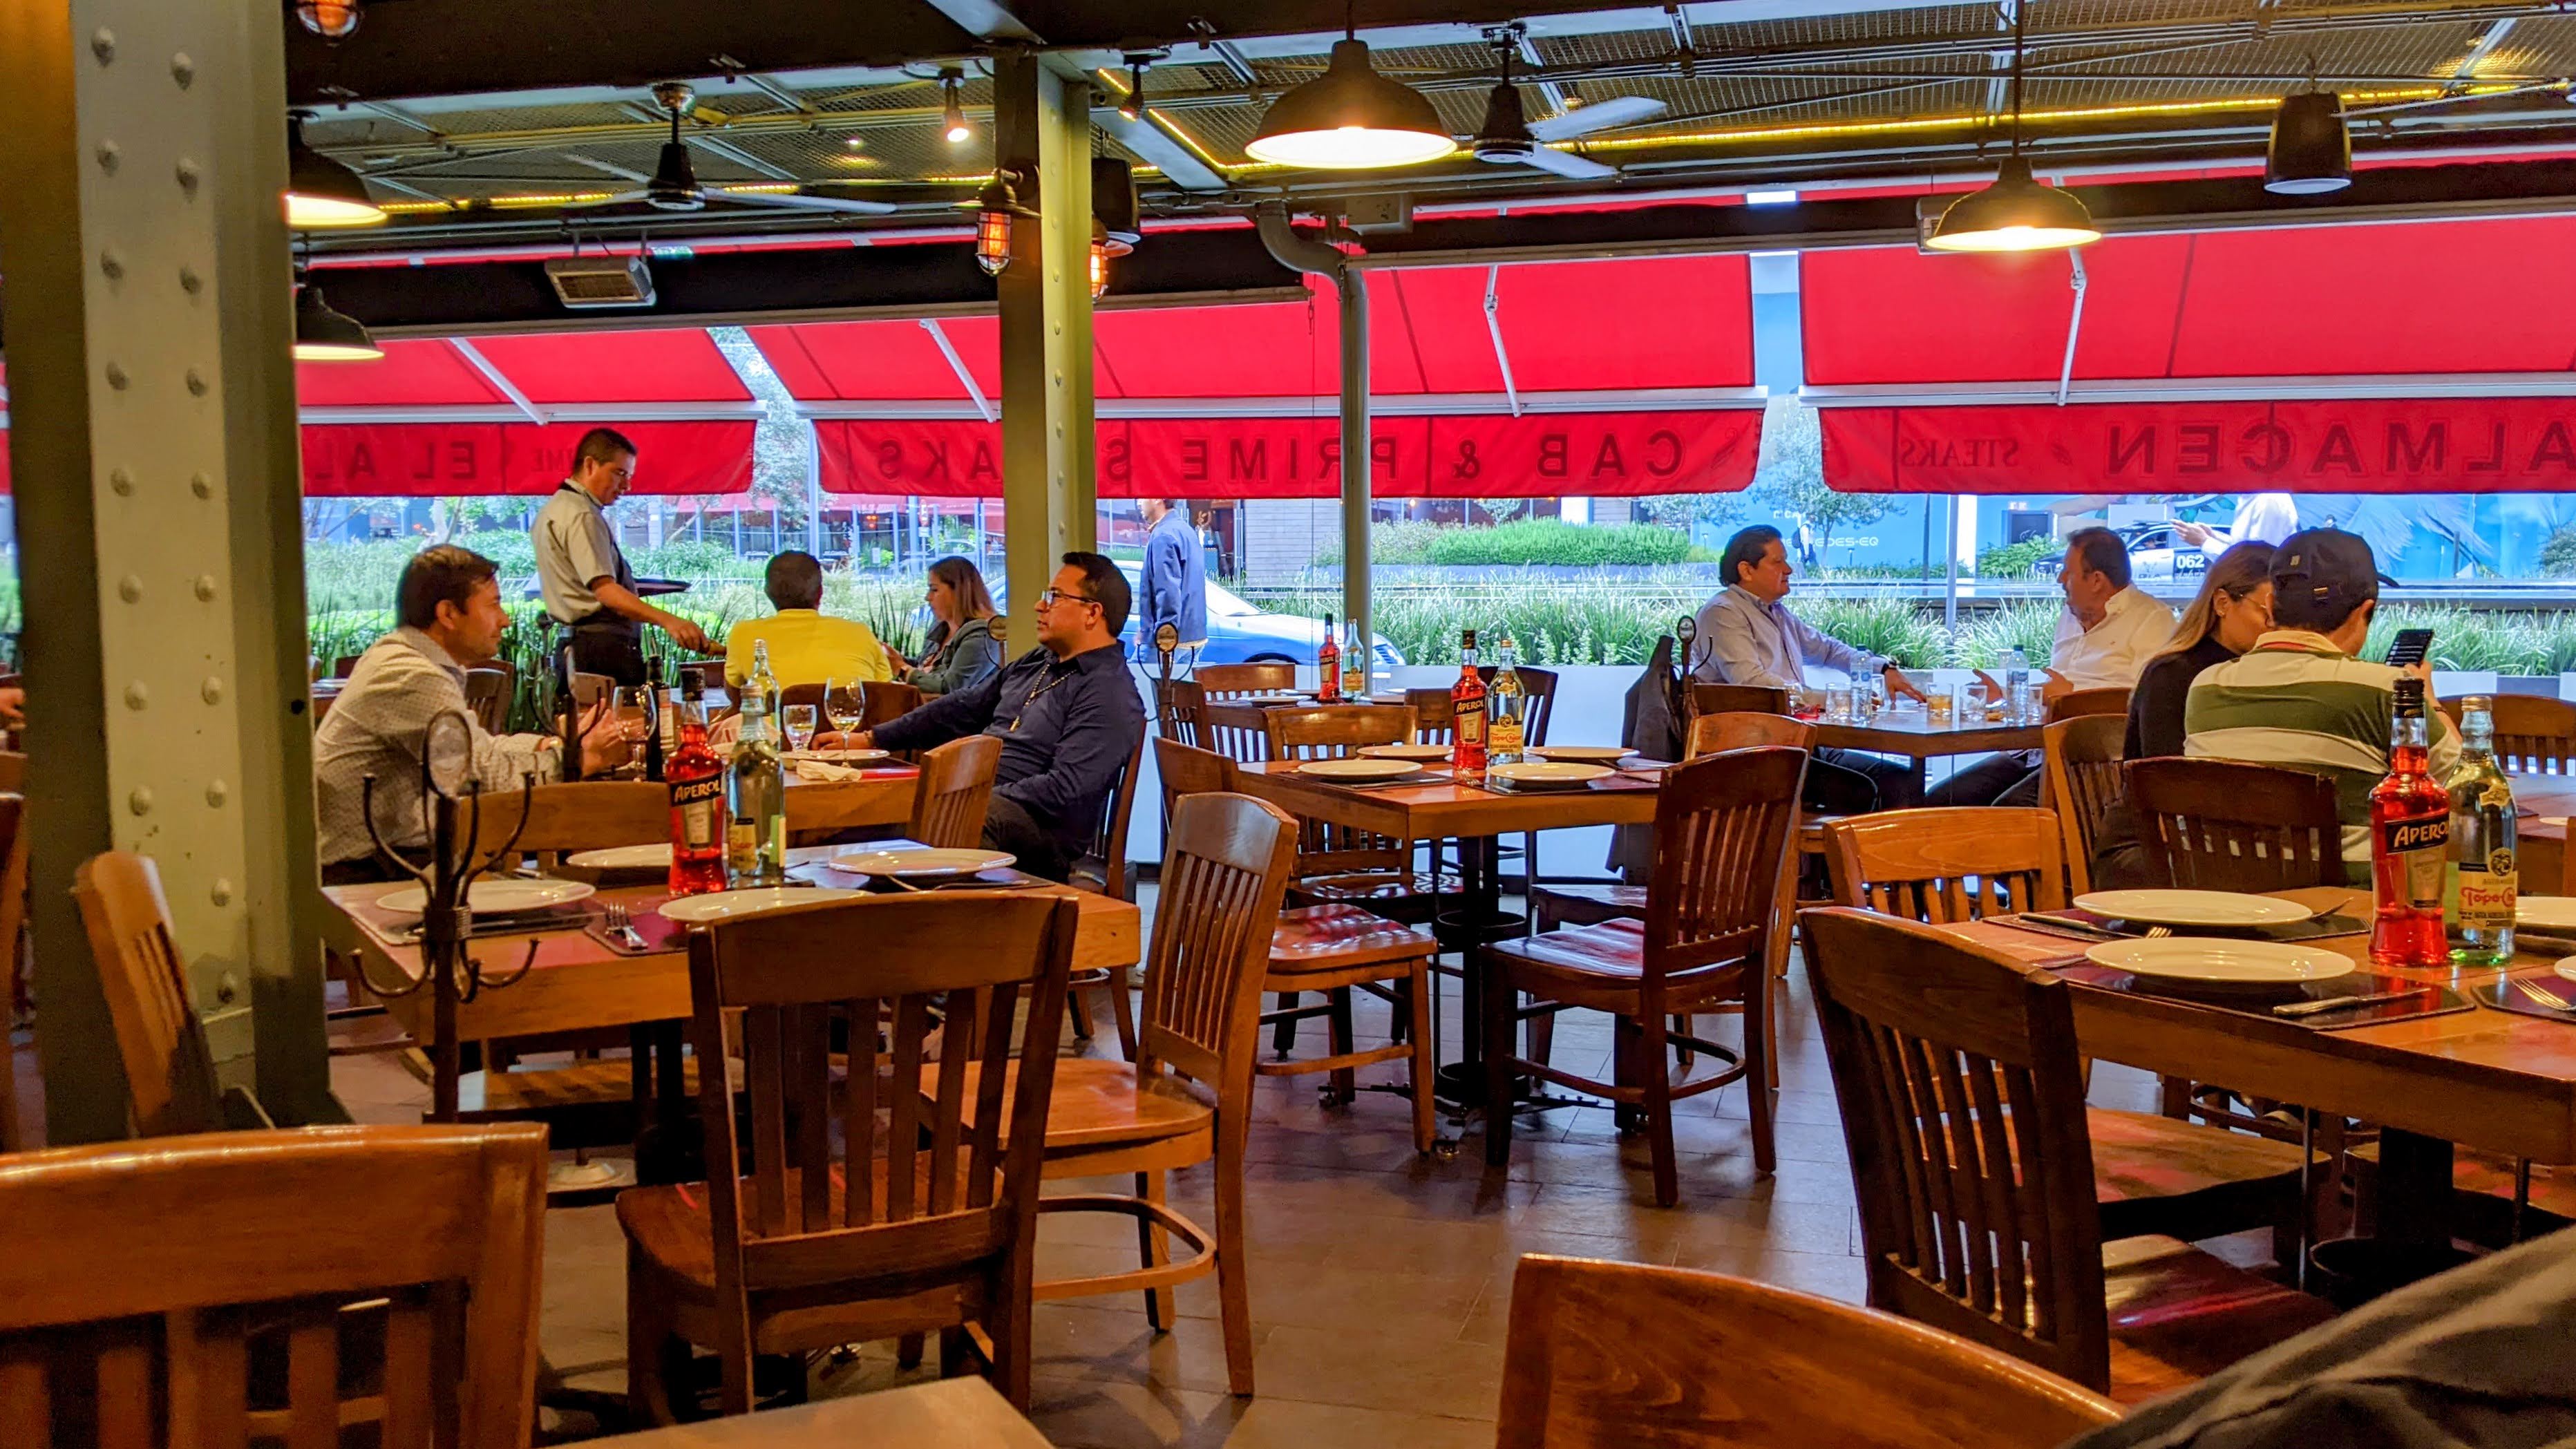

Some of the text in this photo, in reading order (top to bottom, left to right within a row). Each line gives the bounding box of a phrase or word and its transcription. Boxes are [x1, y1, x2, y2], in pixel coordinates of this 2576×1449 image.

[2176, 554, 2205, 569] 062
[674, 779, 720, 803] APEROL
[2461, 887, 2500, 907] Topo
